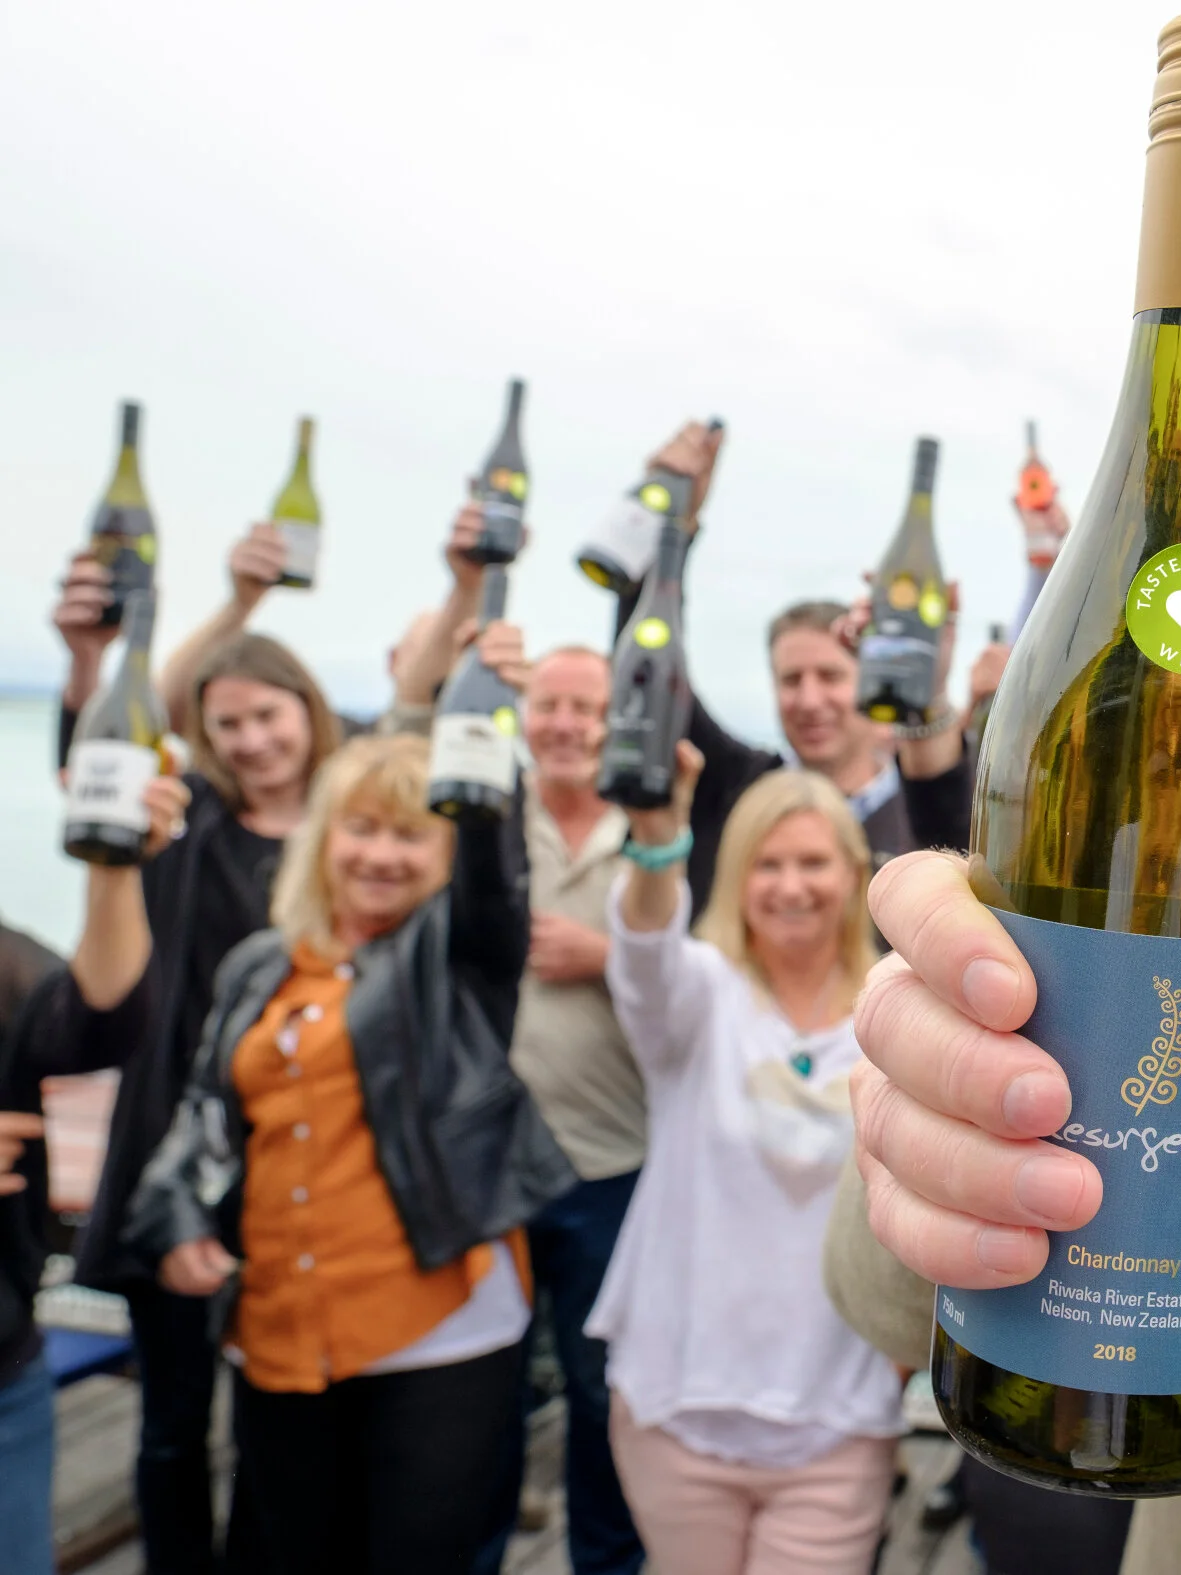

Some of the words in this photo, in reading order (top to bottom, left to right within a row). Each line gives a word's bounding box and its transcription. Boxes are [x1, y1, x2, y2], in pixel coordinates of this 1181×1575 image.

[1137, 557, 1181, 610] TASTE
[1067, 1244, 1181, 1279] Chardonnay
[1048, 1279, 1101, 1304] Riwaka
[1105, 1288, 1145, 1307] River
[954, 1309, 965, 1328] ml
[1040, 1297, 1093, 1325] Nelson,
[1100, 1308, 1137, 1328] New
[1092, 1343, 1137, 1362] 2018
